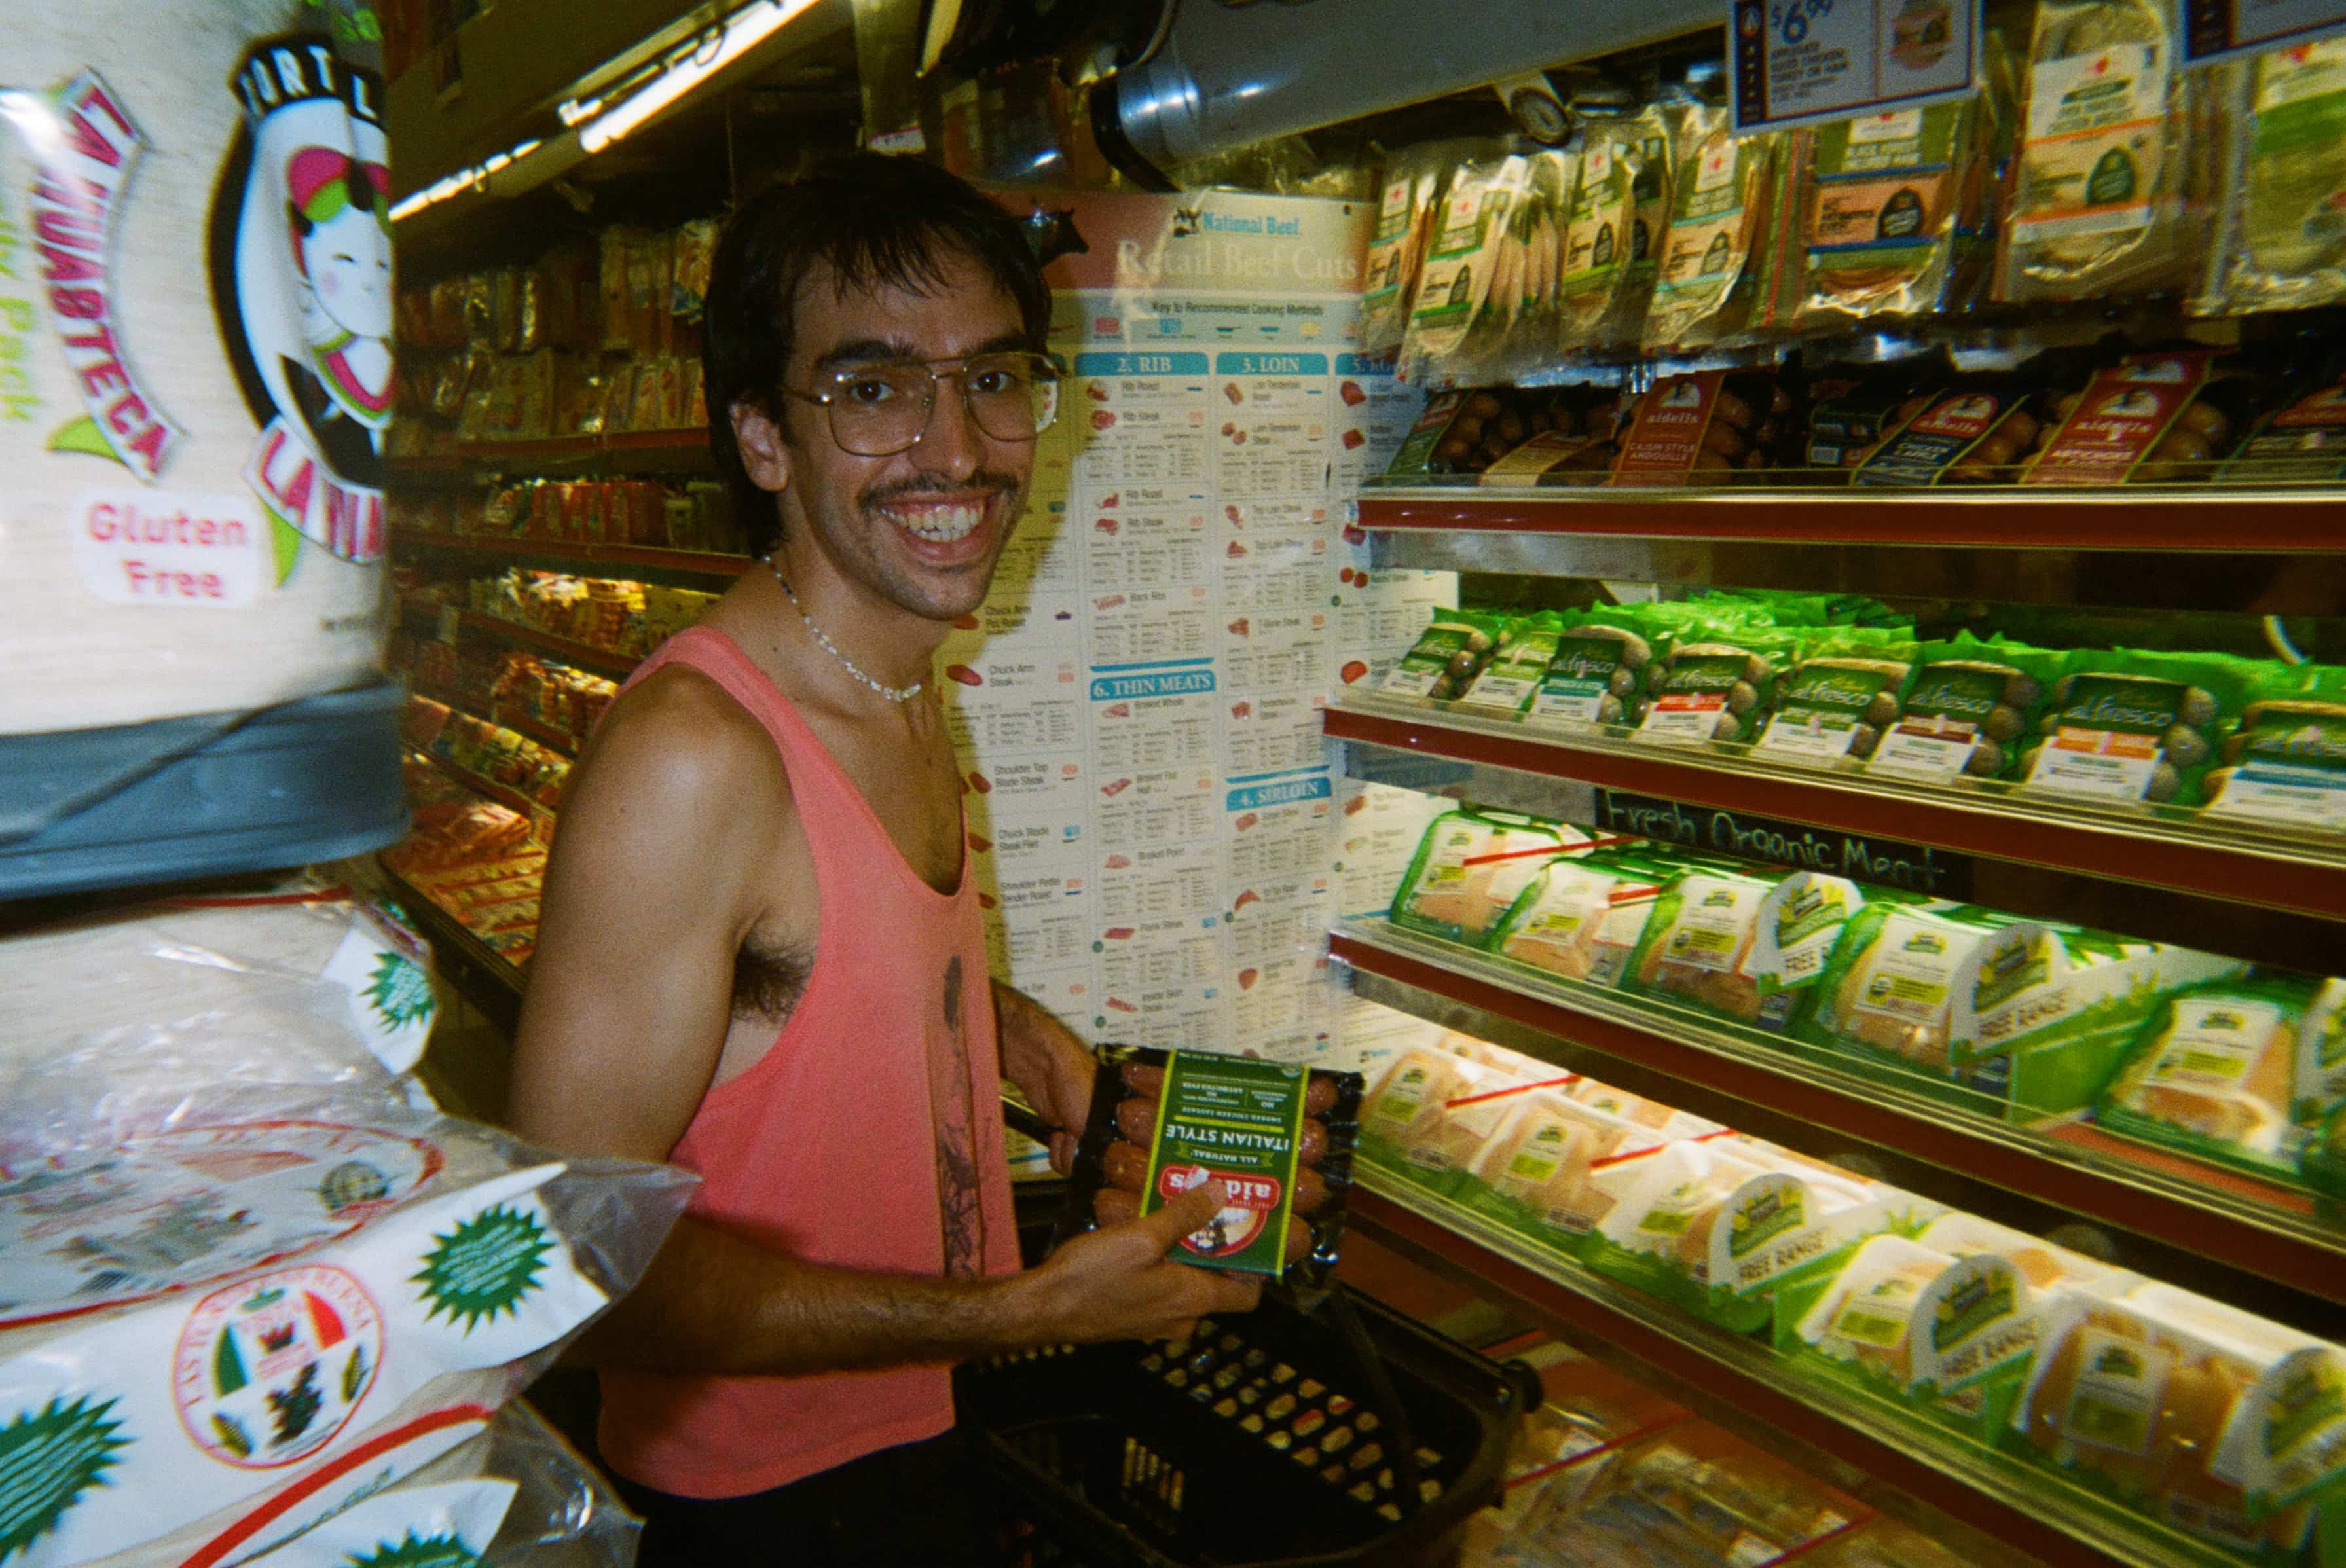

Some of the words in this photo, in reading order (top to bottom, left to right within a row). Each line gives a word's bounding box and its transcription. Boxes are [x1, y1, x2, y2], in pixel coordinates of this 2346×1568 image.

[1203, 211, 1263, 234] National
[1266, 215, 1300, 236] Beef
[1226, 241, 1284, 278] Beef
[1293, 244, 1357, 280] Cuts
[1152, 302, 1175, 315] Key
[1117, 357, 1133, 373] 2.
[1139, 356, 1172, 373] RIB
[1260, 357, 1300, 373] LOIN
[88, 503, 247, 545] Gluten
[122, 560, 224, 599] Free
[990, 665, 1015, 675] Chuck
[1017, 664, 1035, 673] Arm
[1093, 684, 1109, 697] 6.
[1112, 679, 1155, 696] THIN
[1159, 674, 1211, 693] MEATS
[1605, 786, 1696, 839] Fresh
[1712, 811, 1837, 868] Organic
[1165, 1123, 1219, 1142] STYLE
[1222, 1131, 1289, 1152] ITALIAN
[1241, 1154, 1259, 1164] ALL
[1169, 1173, 1272, 1200] aids
